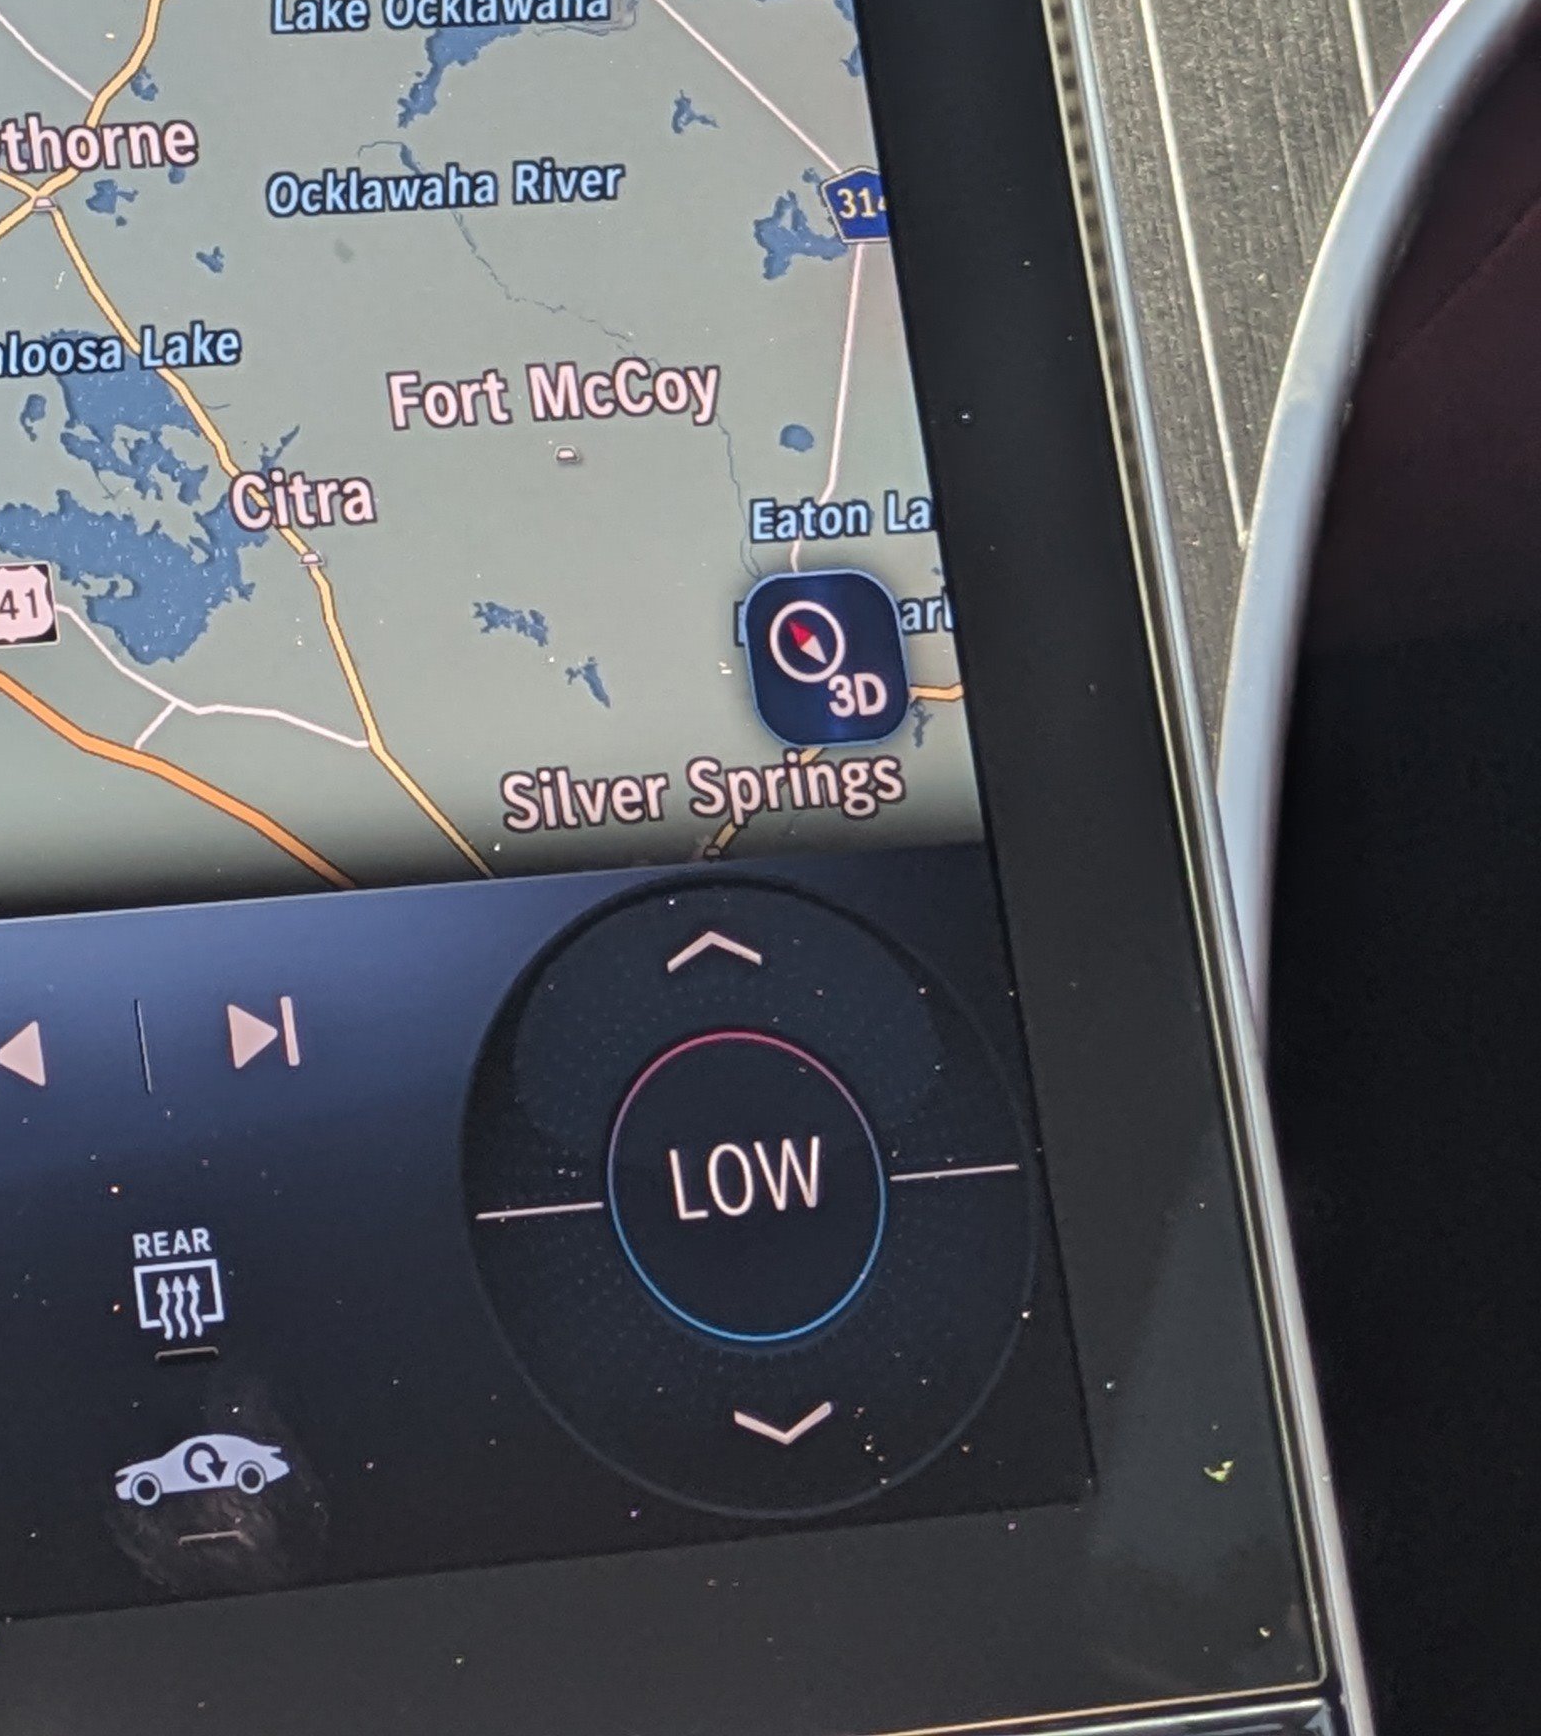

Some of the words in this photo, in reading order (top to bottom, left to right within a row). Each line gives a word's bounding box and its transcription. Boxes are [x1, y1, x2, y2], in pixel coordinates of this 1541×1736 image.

[266, 169, 498, 218] Ocklawaha
[513, 162, 625, 207] River
[140, 323, 242, 370] Lake
[387, 370, 511, 431] Fort
[527, 359, 721, 425] McCoy
[228, 470, 378, 531] Citra
[750, 497, 870, 544] Eaton
[827, 672, 888, 718] 3D
[501, 761, 670, 833] Silver
[686, 753, 906, 823] Springs
[668, 1137, 823, 1224] LOW
[132, 1227, 215, 1259] REAR
